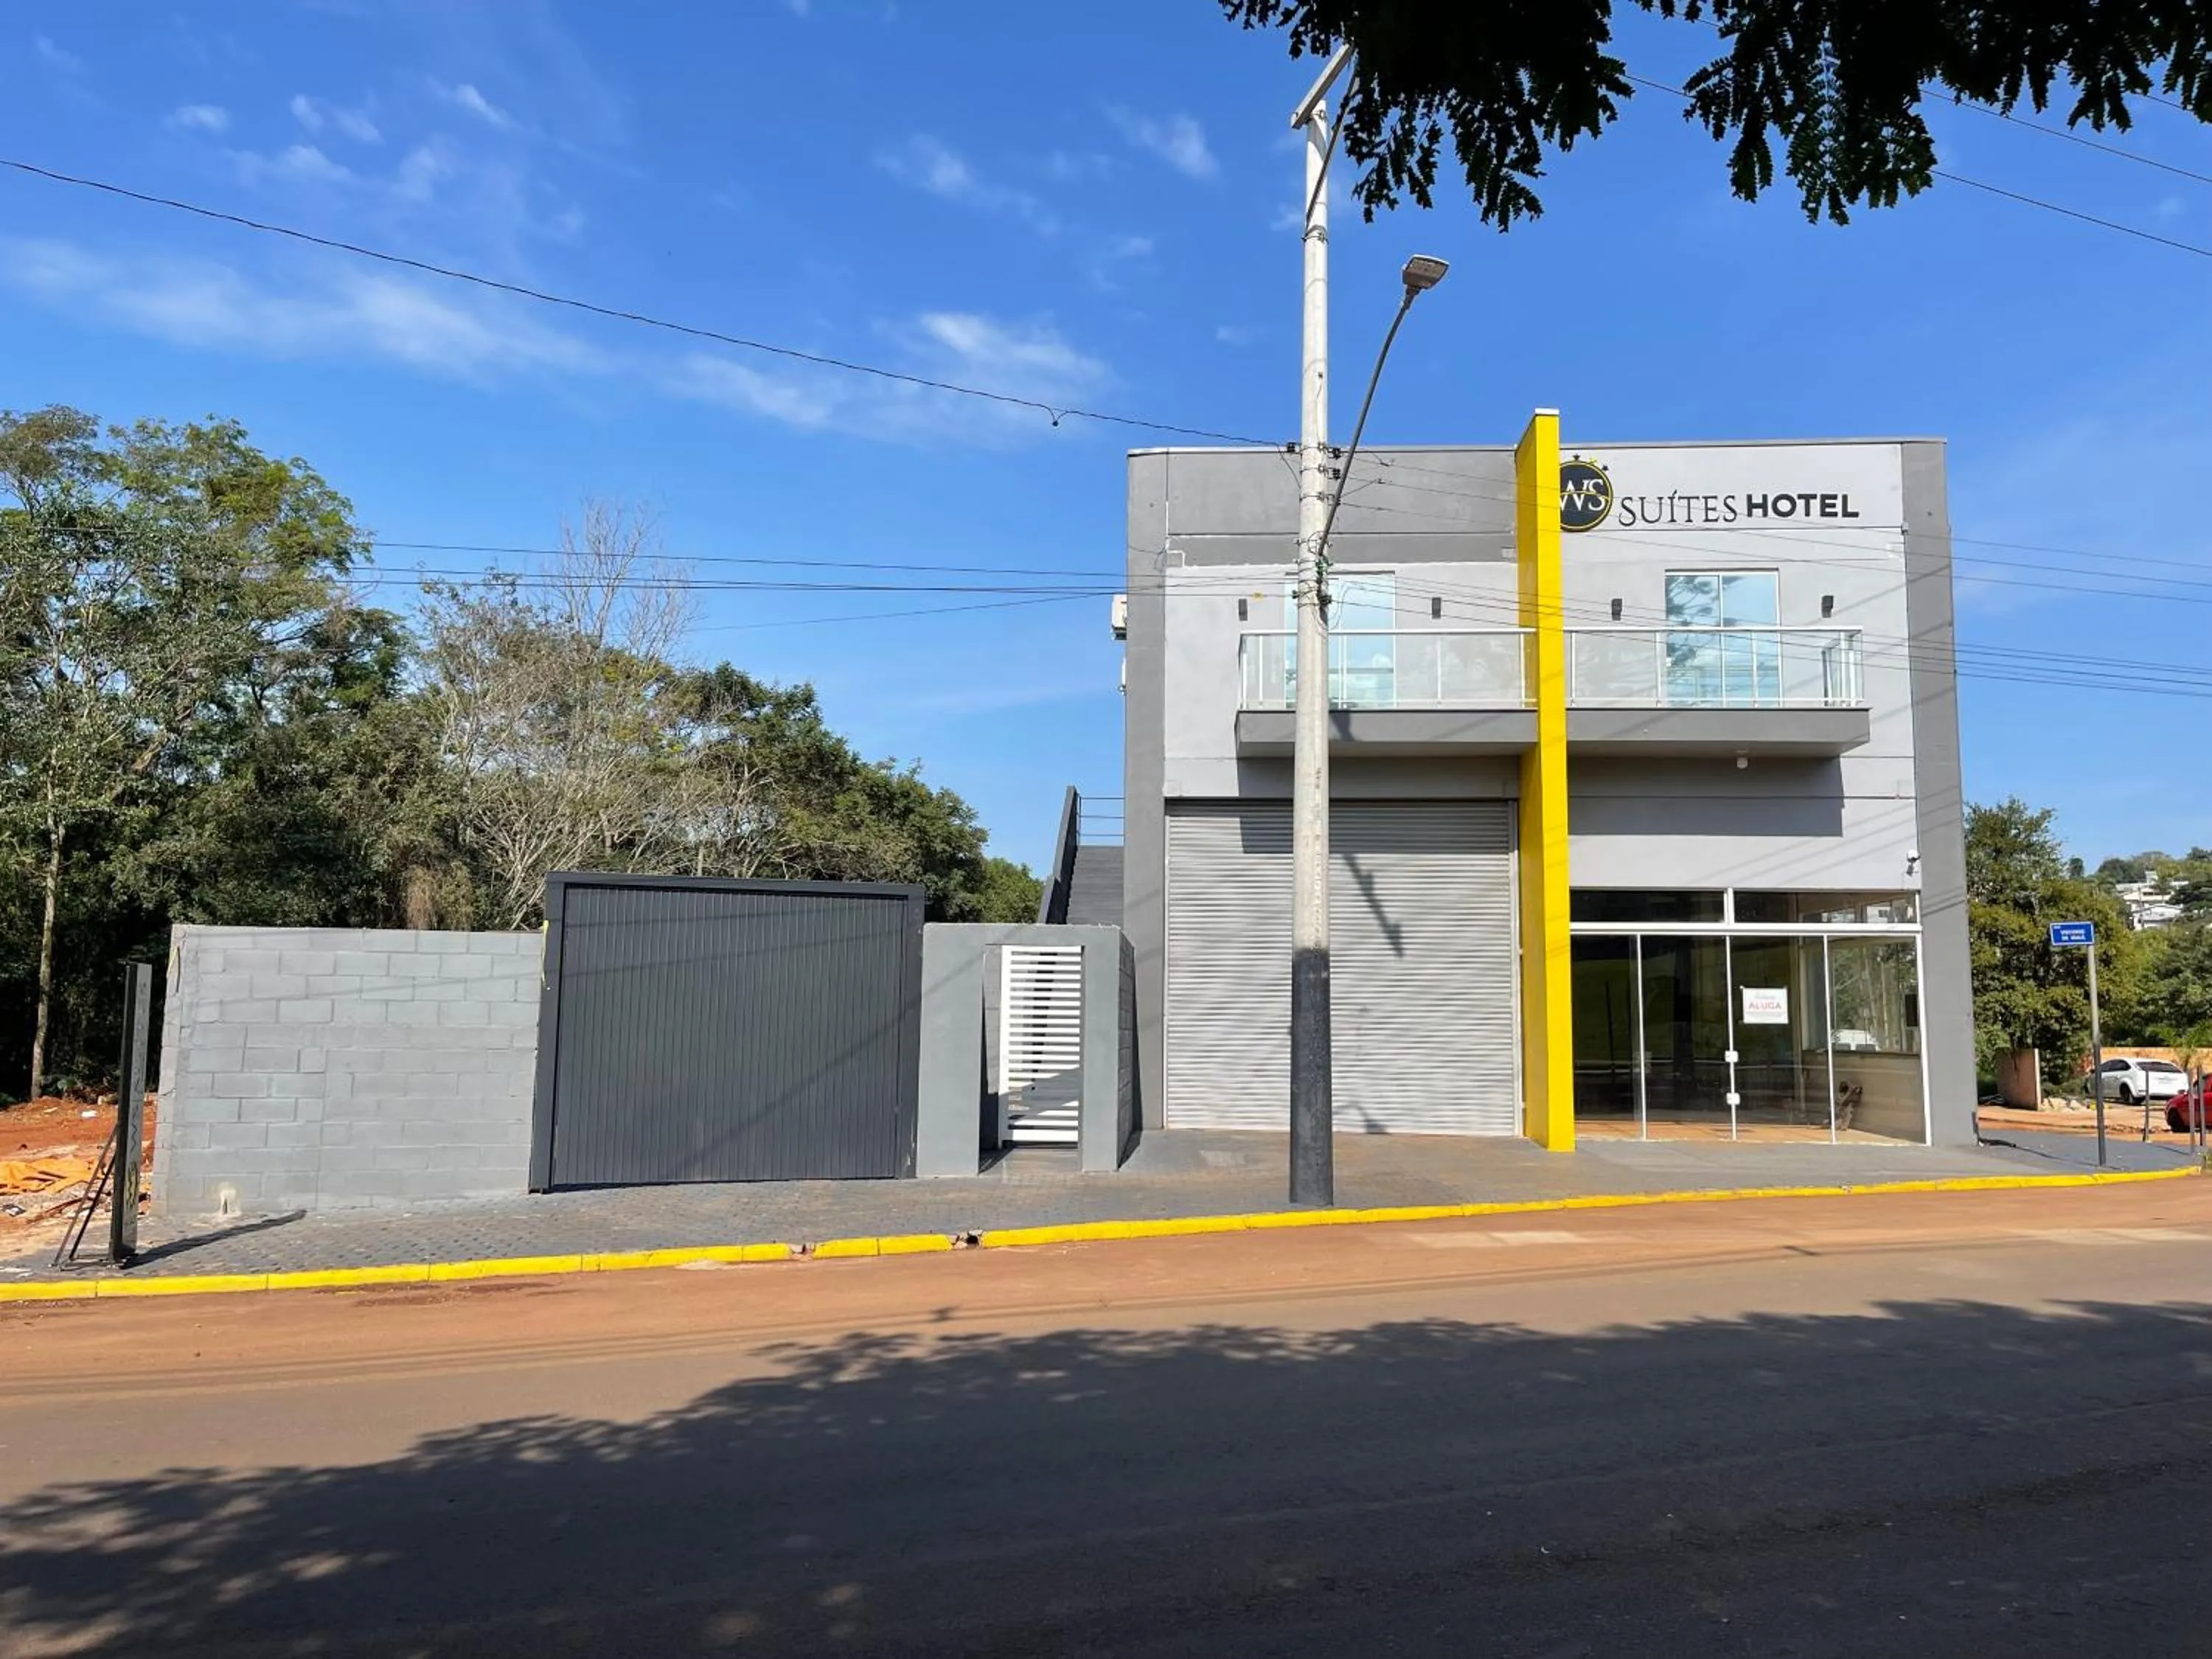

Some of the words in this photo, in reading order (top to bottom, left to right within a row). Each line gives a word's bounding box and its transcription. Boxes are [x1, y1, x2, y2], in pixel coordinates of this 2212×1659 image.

[1618, 489, 1738, 526] SUÍTES
[1746, 493, 1860, 518] HOTEL
[1748, 1001, 1782, 1010] ALUGA
